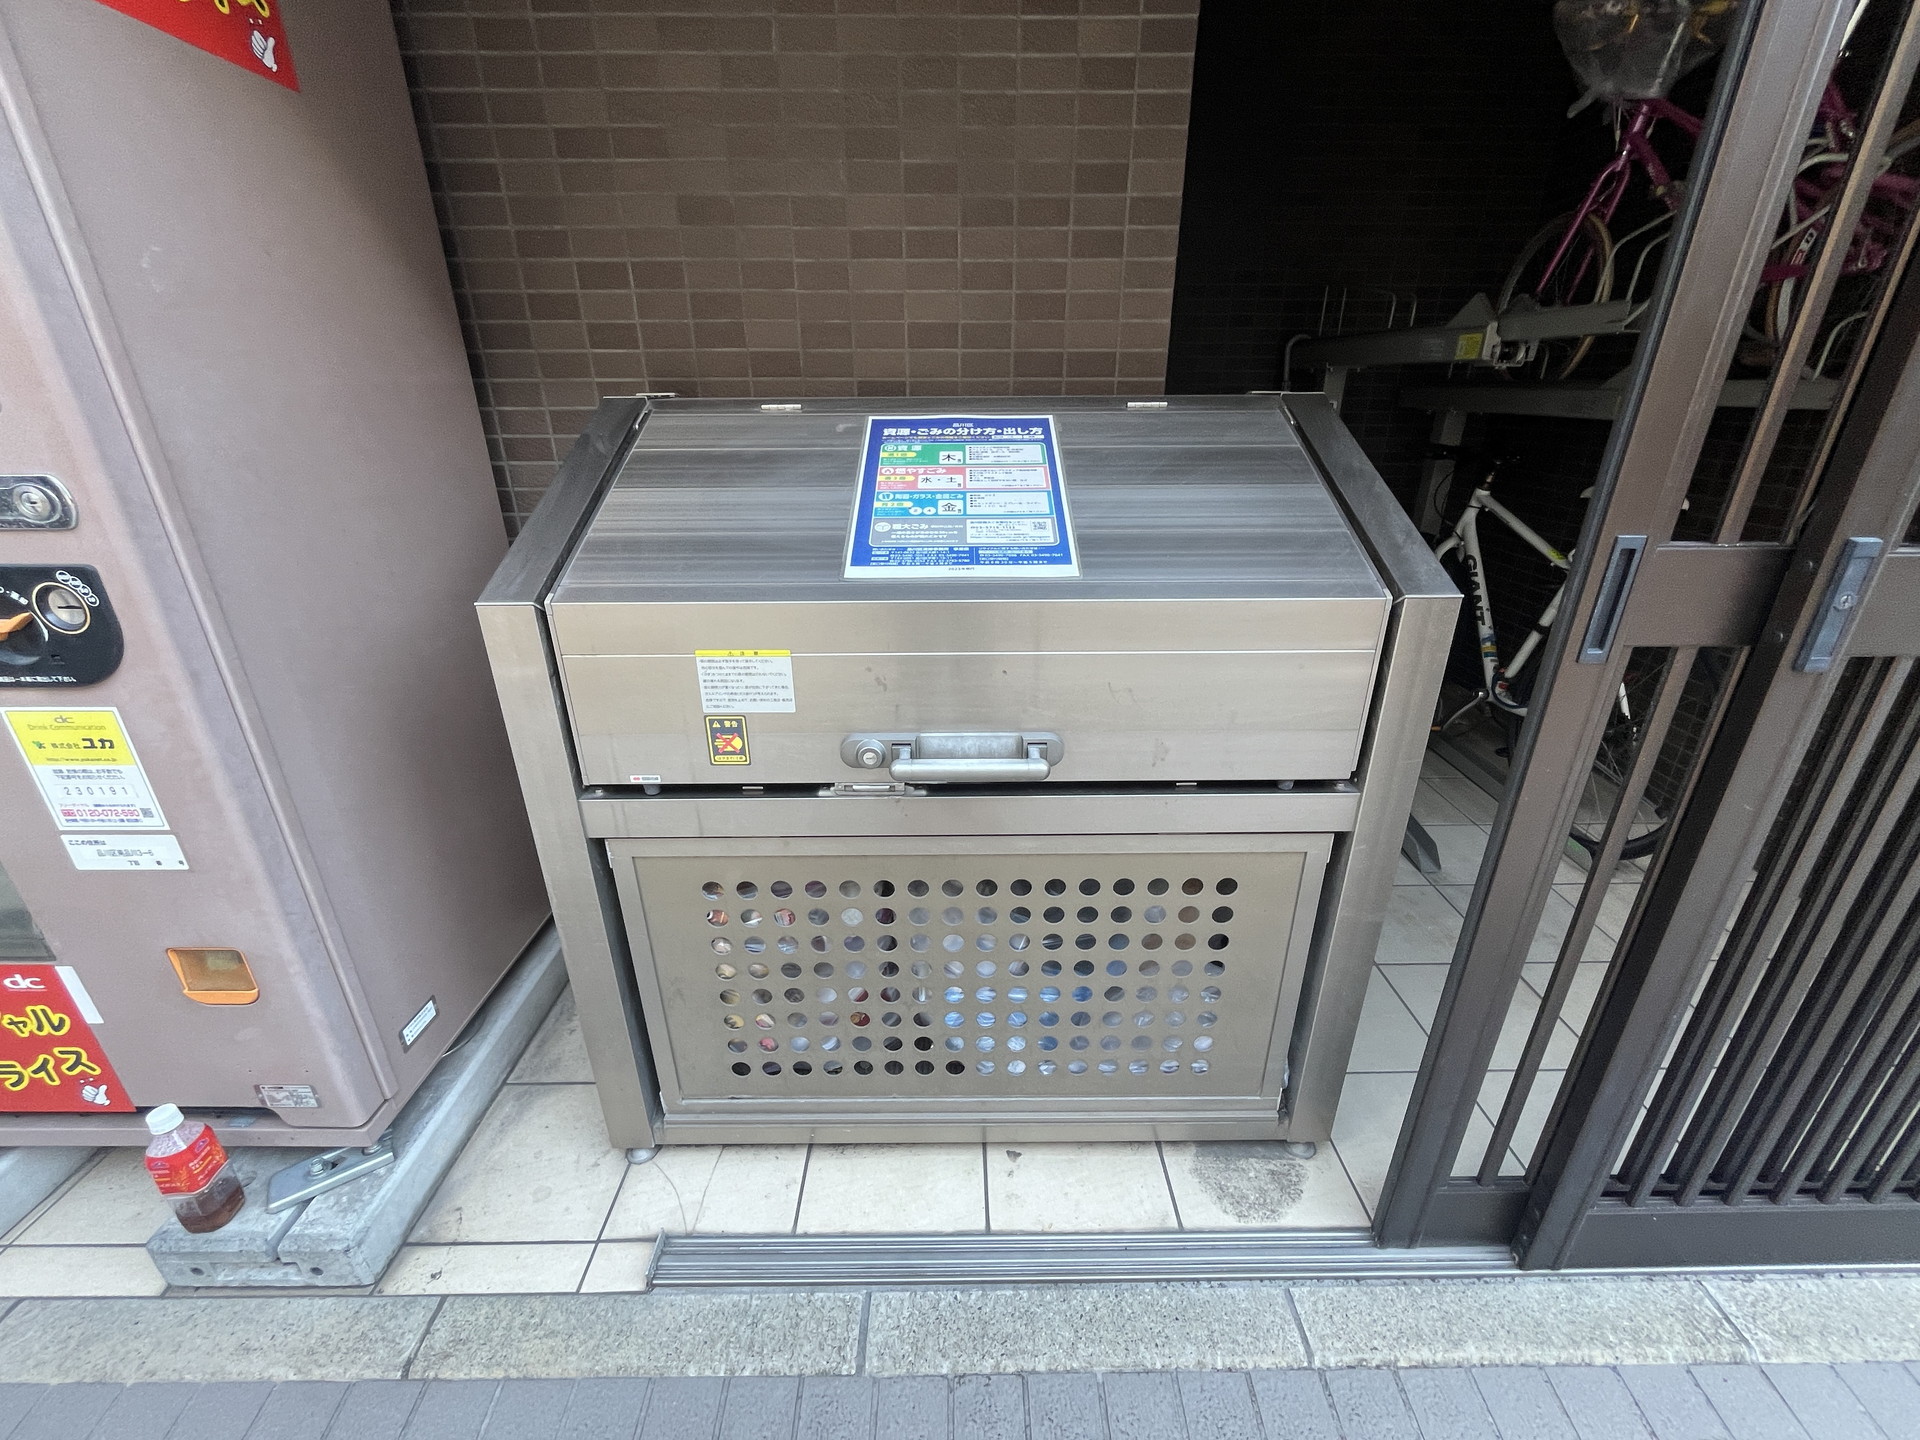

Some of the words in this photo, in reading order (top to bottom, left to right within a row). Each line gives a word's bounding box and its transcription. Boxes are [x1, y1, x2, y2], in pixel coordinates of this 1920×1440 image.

[883, 427, 1043, 436] 資源・ごみの分け方・出し方
[941, 453, 957, 462] 木
[941, 502, 957, 512] 金
[1466, 554, 1486, 626] GIANT
[54, 715, 75, 723] dc
[3, 974, 46, 989] dc
